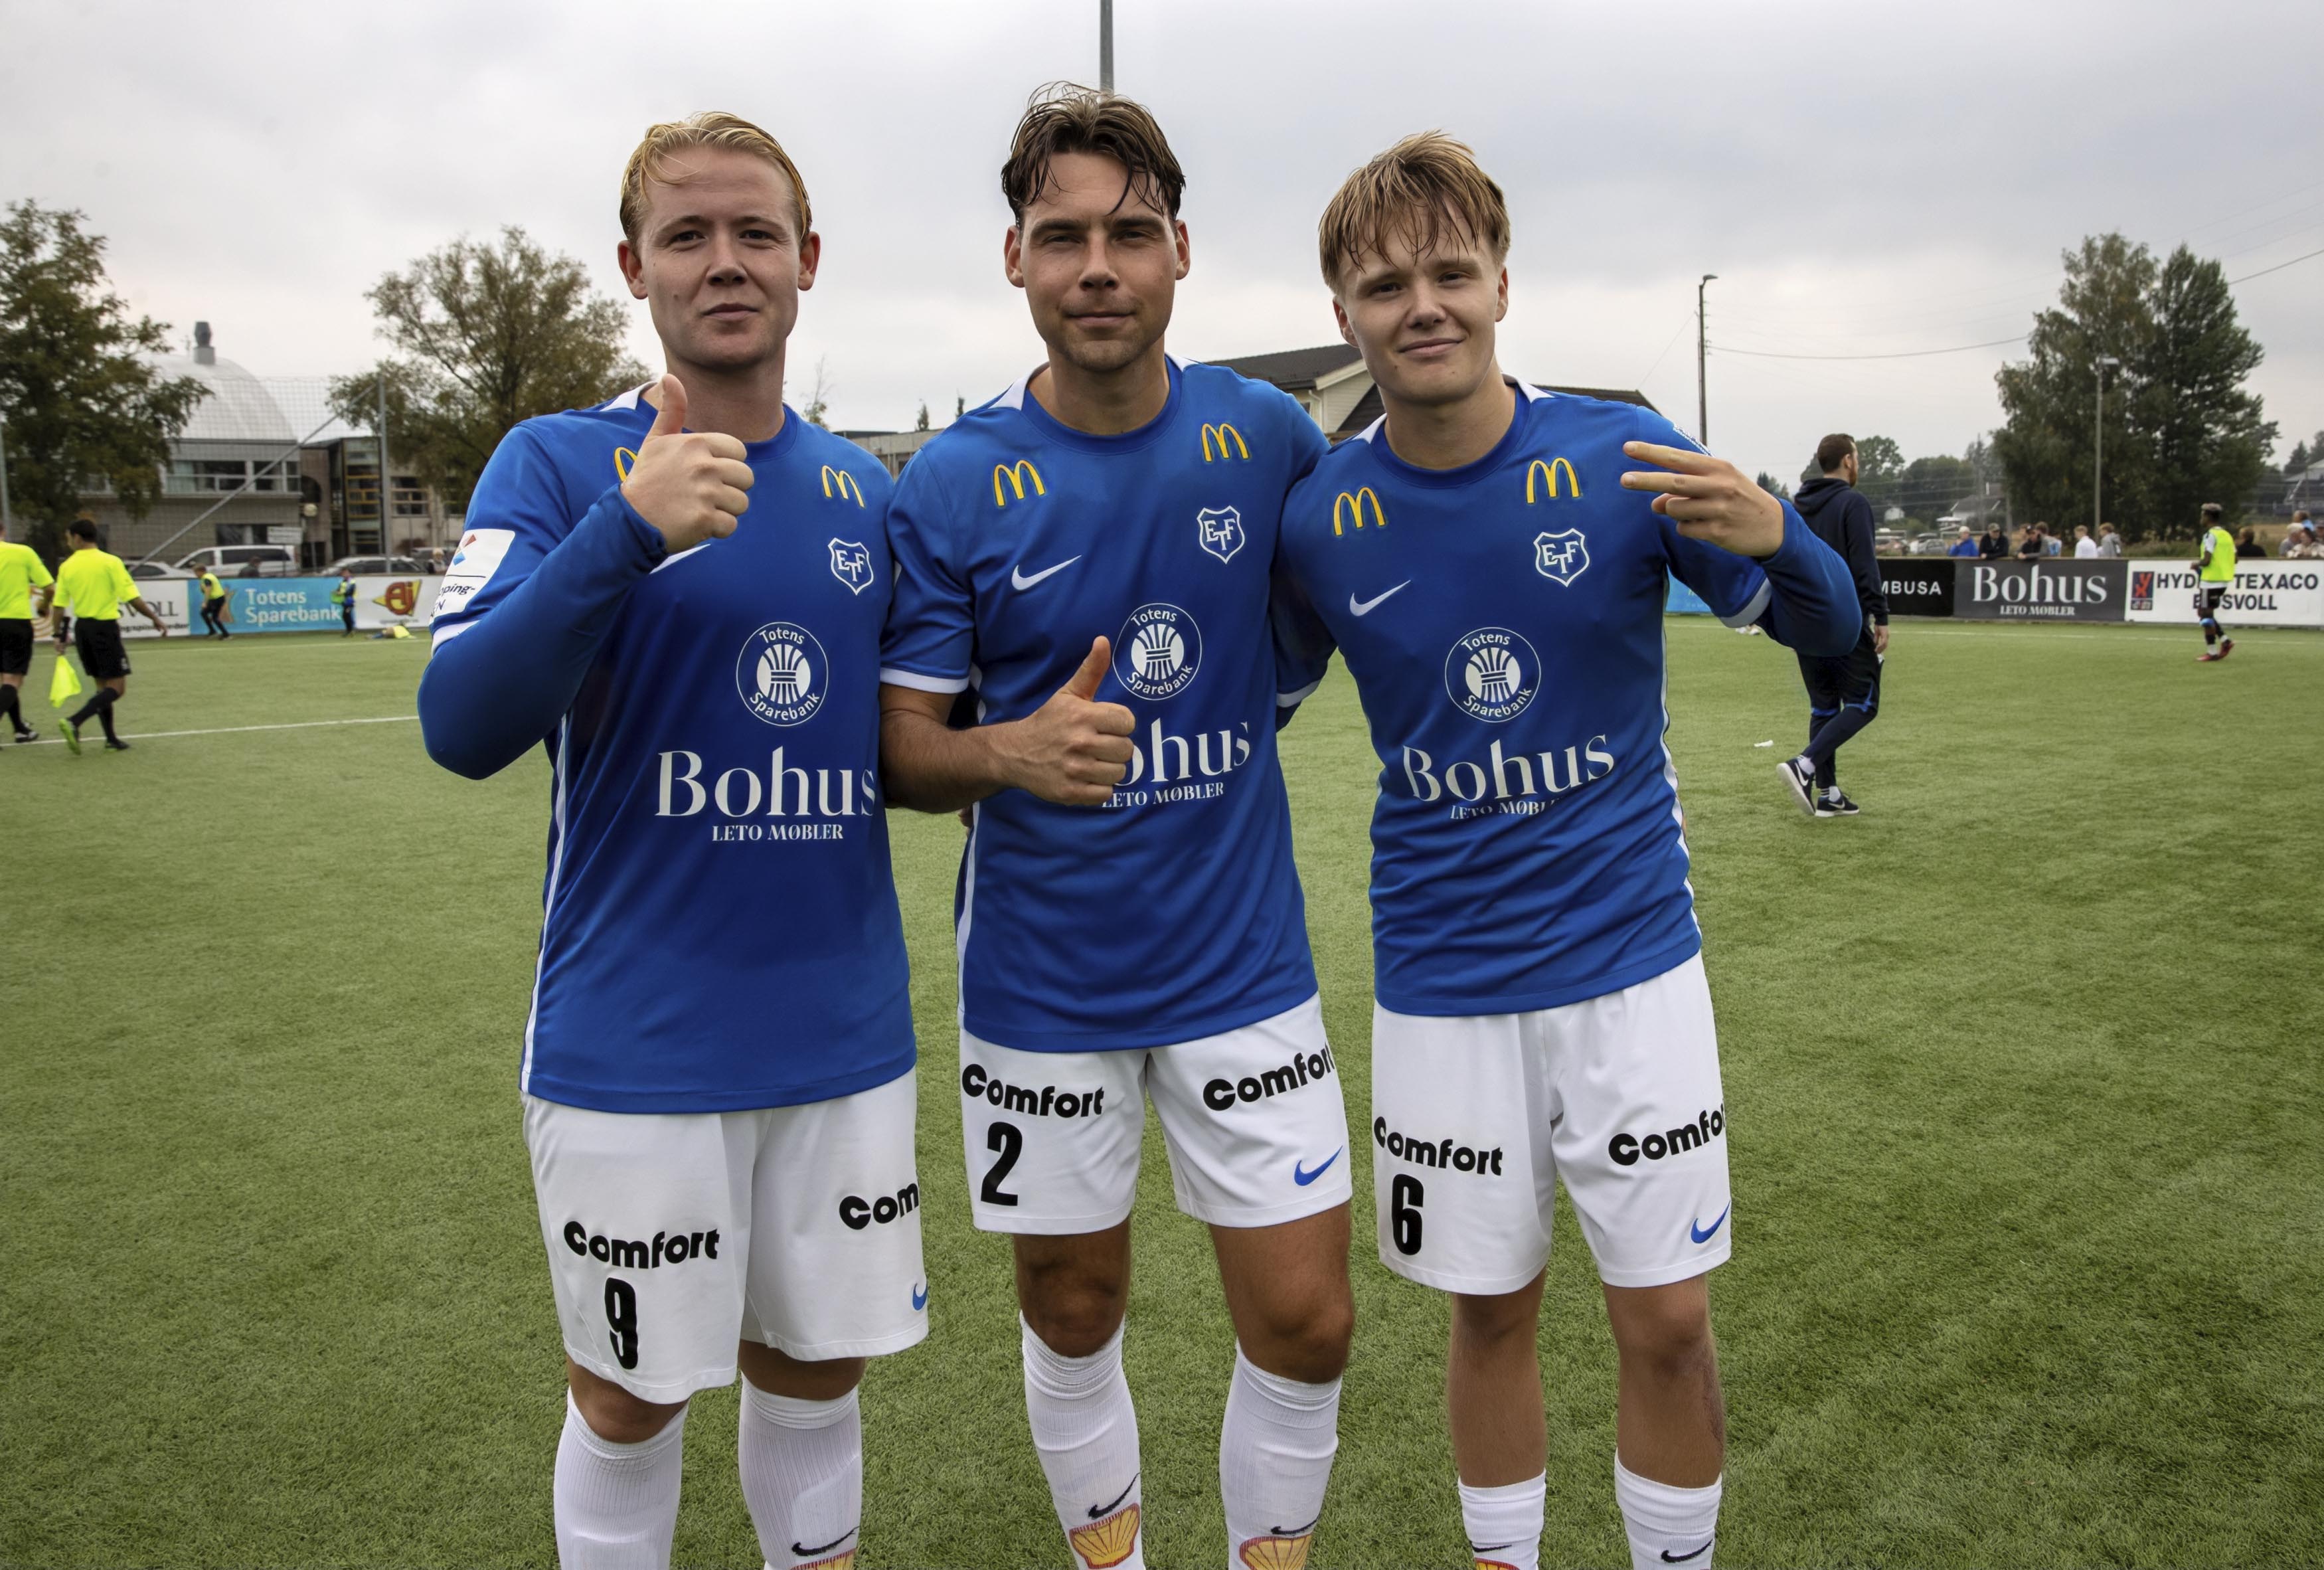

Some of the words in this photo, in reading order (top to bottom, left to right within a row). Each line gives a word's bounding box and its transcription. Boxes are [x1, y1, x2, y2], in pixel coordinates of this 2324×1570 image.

[244, 588, 307, 605] Totens
[1972, 565, 2108, 603] Bohus
[245, 606, 341, 626] Sparebank
[1131, 608, 1177, 626] Totens
[1999, 604, 2027, 616] LETO
[759, 626, 805, 644] Totens
[1461, 632, 1510, 651] Totens
[1126, 665, 1193, 695] Sparebank
[750, 692, 819, 721] Sparebank
[1463, 688, 1532, 717] Sparebank
[654, 745, 876, 818] Bohus
[1402, 734, 1615, 802] Bohus
[1152, 782, 1224, 805] MØBLER
[712, 825, 762, 841] LETO
[767, 824, 843, 840] MØBLER
[961, 1063, 1104, 1118] Comfort
[1374, 1116, 1503, 1176] Comfort
[980, 1121, 1023, 1207] 2
[1391, 1174, 1424, 1256] 6
[564, 1221, 720, 1269] Comfort
[604, 1277, 639, 1370] 9
